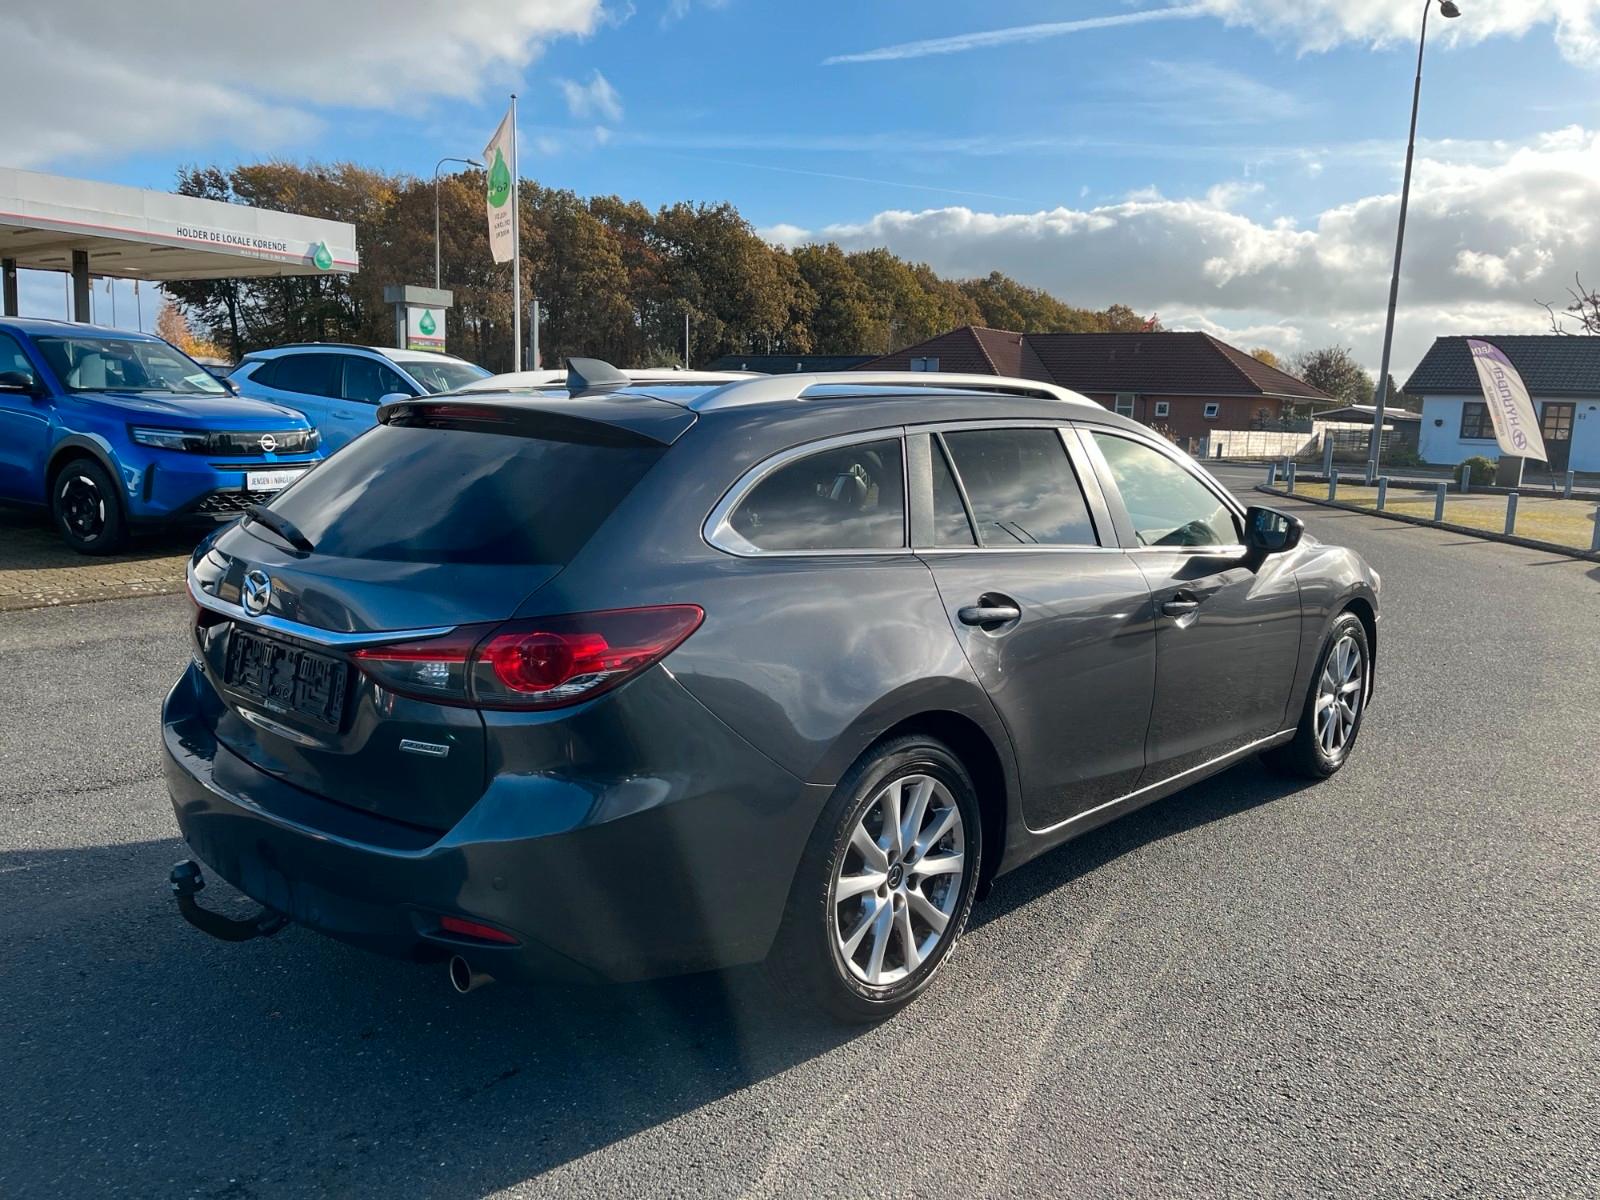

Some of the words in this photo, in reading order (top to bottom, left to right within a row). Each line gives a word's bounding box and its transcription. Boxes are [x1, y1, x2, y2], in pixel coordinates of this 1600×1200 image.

[176, 227, 208, 240] HOLDER
[210, 233, 220, 241] DE
[222, 234, 250, 246] LOKALE
[253, 239, 287, 252] KØRENDE
